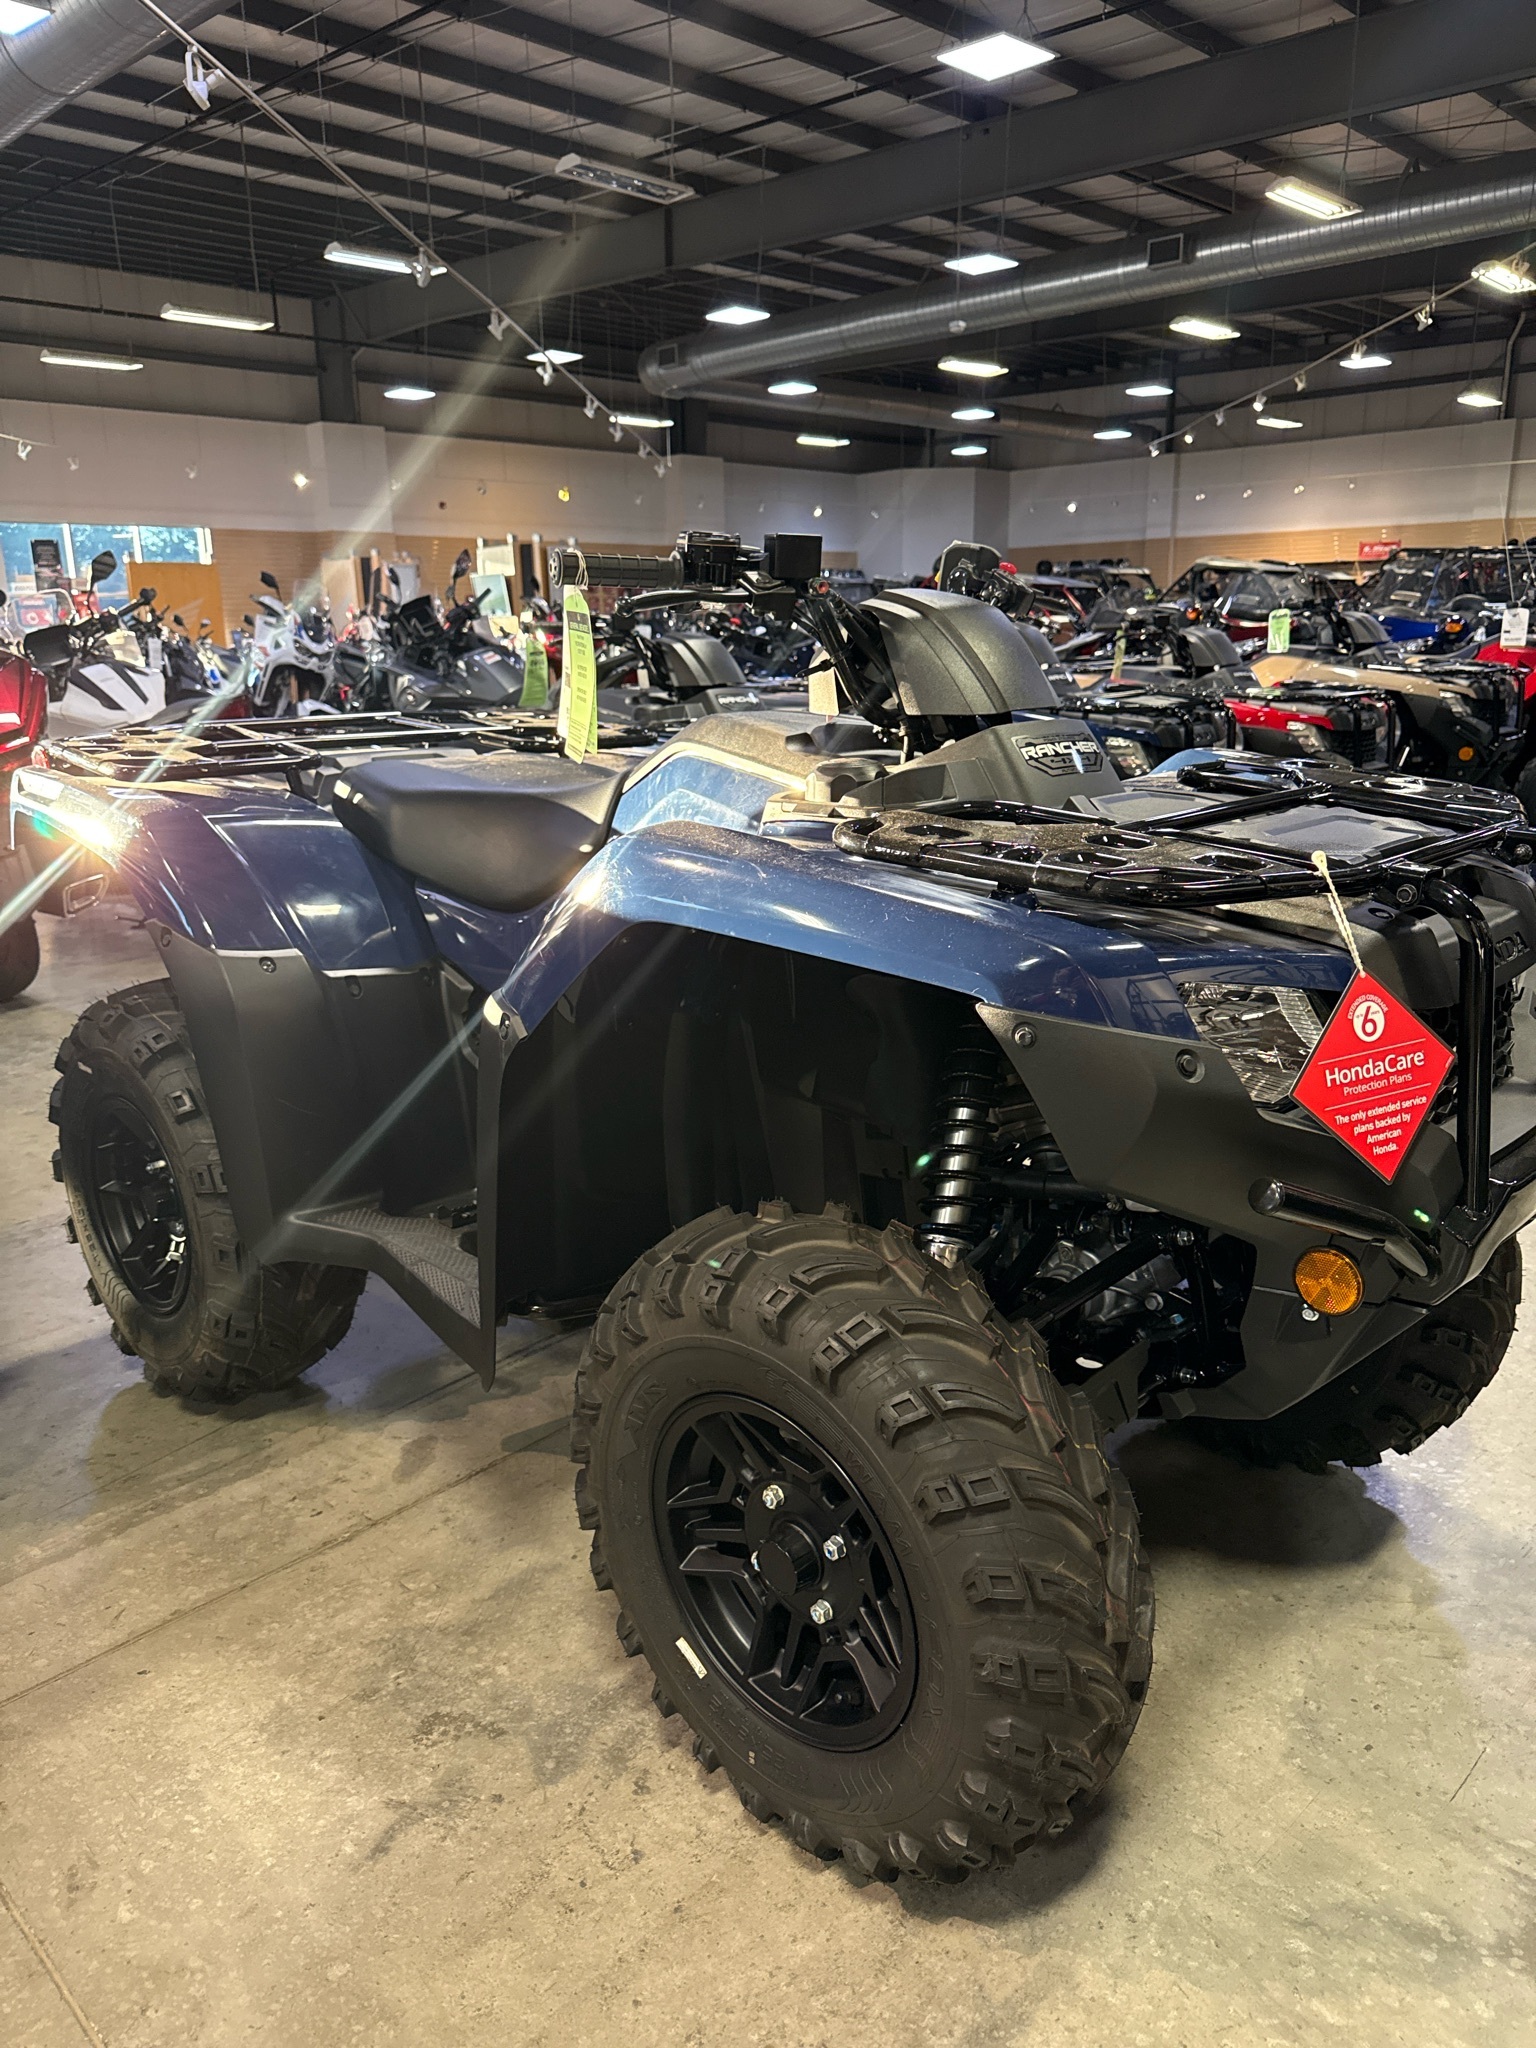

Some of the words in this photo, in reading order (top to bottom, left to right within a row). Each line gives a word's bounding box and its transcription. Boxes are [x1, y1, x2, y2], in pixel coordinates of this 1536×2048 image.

[1020, 741, 1100, 760] RANCHER
[1347, 994, 1366, 1020] EXTENDED
[1366, 993, 1389, 1014] COVERAGE
[1361, 1005, 1377, 1037] 6
[1325, 1053, 1425, 1087] HondaCare
[1343, 1078, 1388, 1097] Protection
[1389, 1072, 1413, 1086] Plans
[1335, 1114, 1350, 1126] The
[1350, 1110, 1367, 1123] only
[1367, 1101, 1401, 1118] extended
[1401, 1095, 1427, 1109] service
[1353, 1122, 1375, 1136] plans
[1375, 1114, 1402, 1129] backed
[1402, 1112, 1411, 1123] by
[1366, 1128, 1402, 1144] American
[1373, 1143, 1399, 1156] Honda.
